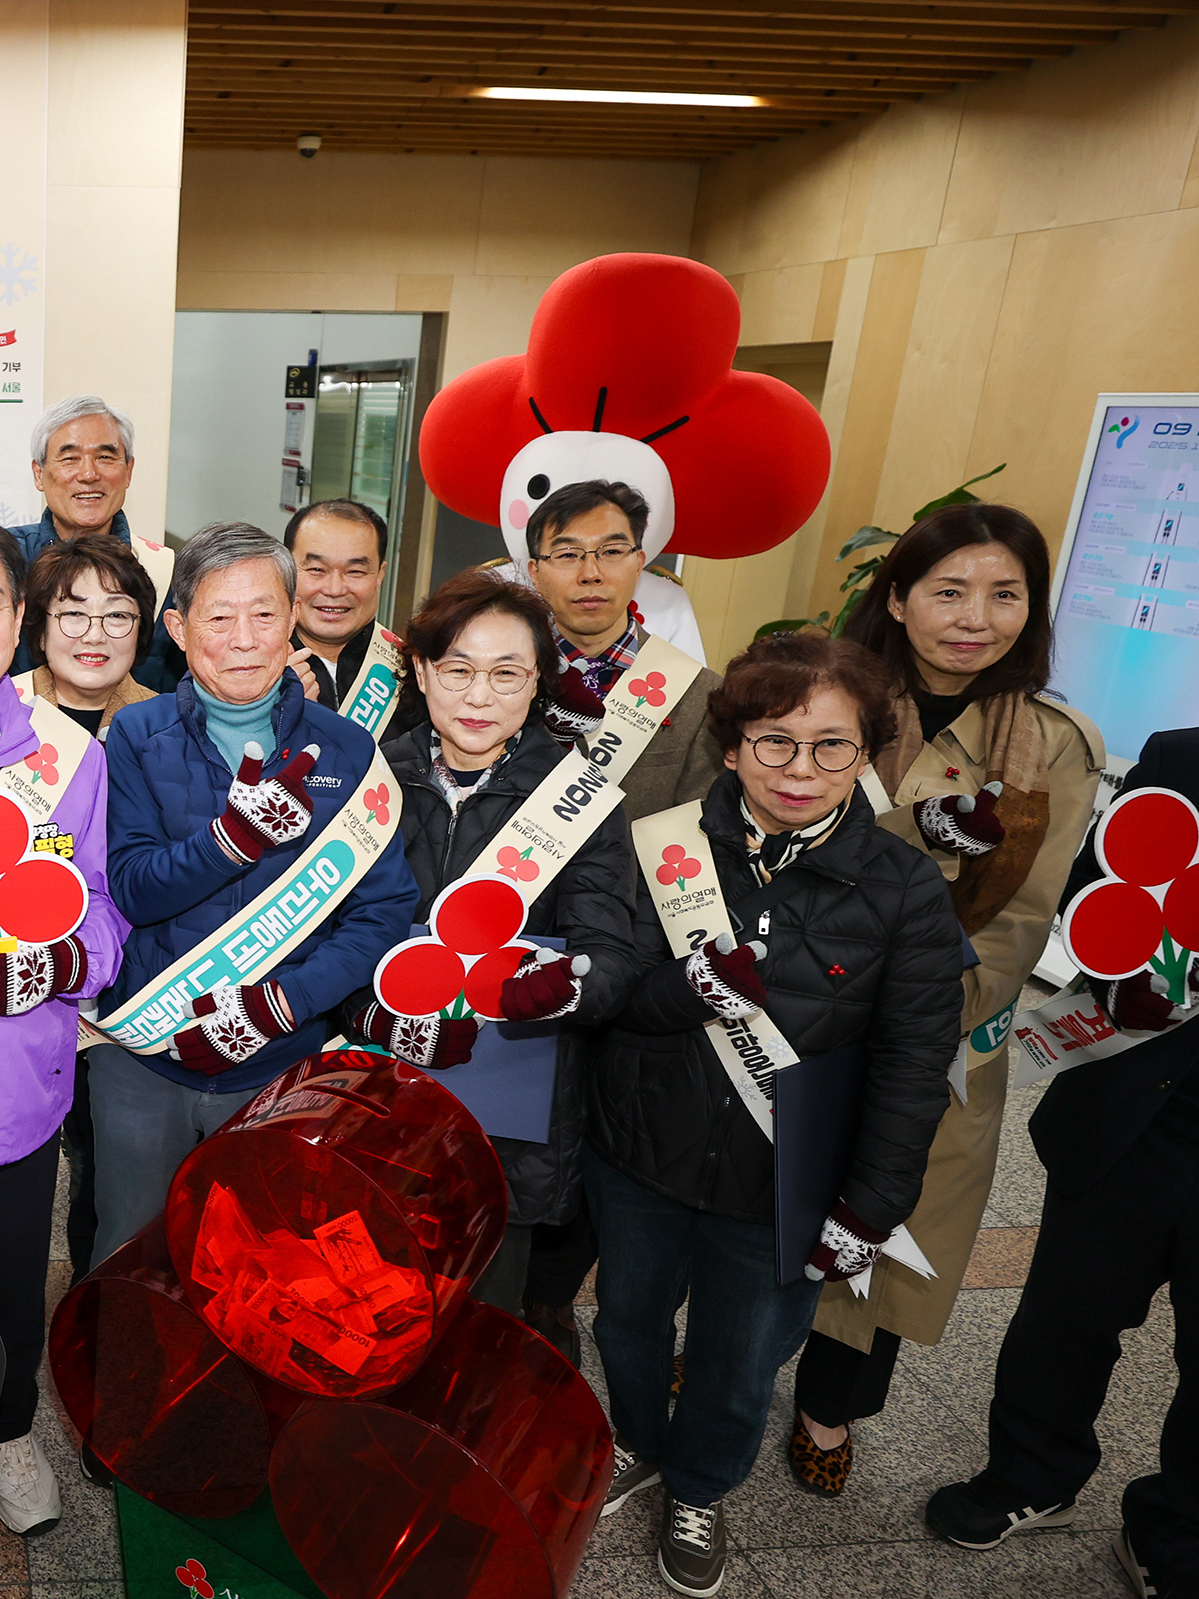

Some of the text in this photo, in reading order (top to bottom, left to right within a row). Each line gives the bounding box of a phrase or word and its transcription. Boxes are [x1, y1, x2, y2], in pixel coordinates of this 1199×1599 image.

[2, 361, 21, 372] 기부
[2, 382, 21, 393] 서울
[609, 698, 657, 730] 사랑의열매
[5, 769, 52, 812] 사랑의열매
[344, 808, 380, 851] 사랑의열매
[660, 886, 718, 911] 사랑의열매
